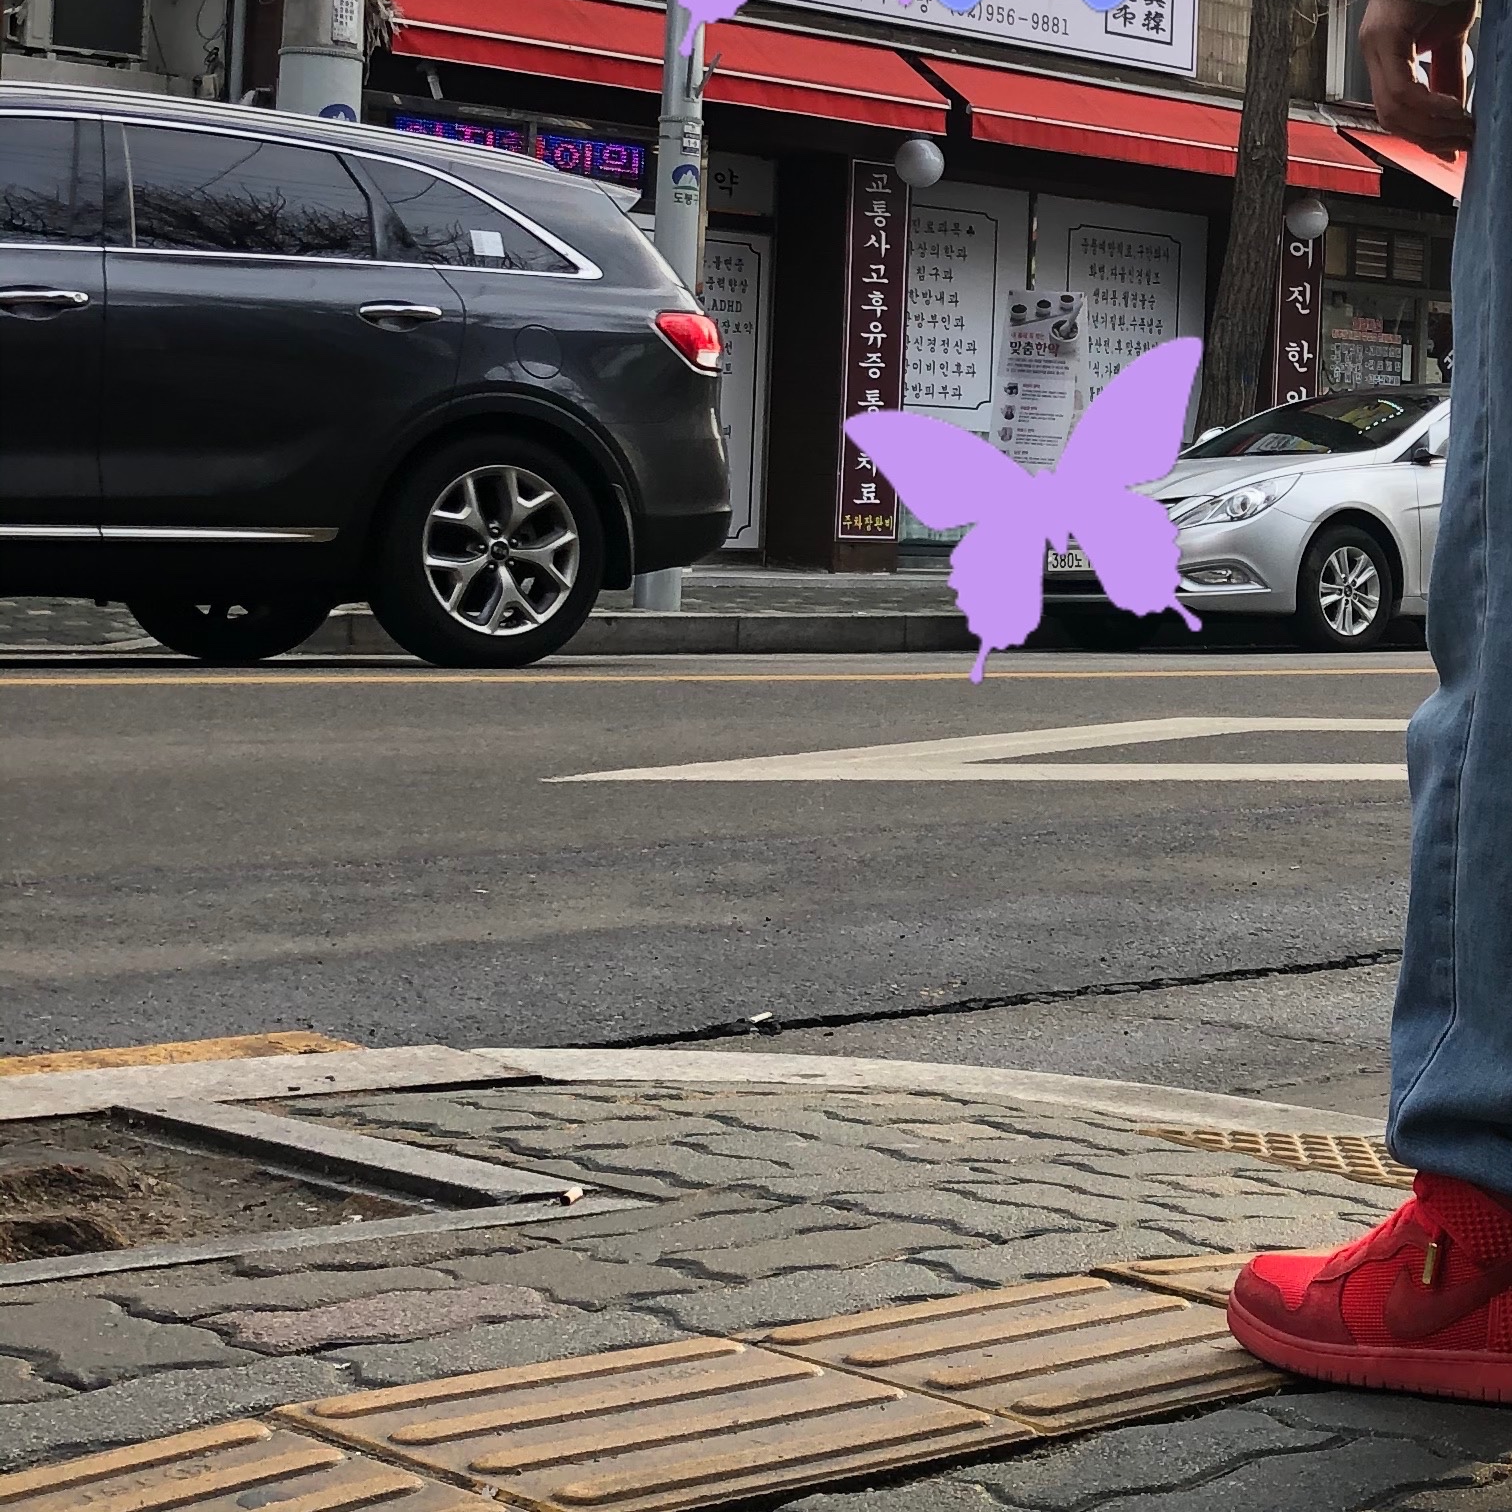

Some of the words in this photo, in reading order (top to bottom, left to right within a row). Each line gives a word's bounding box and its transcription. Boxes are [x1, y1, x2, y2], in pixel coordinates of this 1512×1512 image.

[857, 173, 892, 379] 교통사고후유증
[916, 265, 954, 283] 침구과
[908, 288, 960, 308] 한방내과
[1009, 341, 1060, 358] 맞춤한약
[842, 514, 893, 532] 주차장완비
[1052, 552, 1083, 569] 380노
